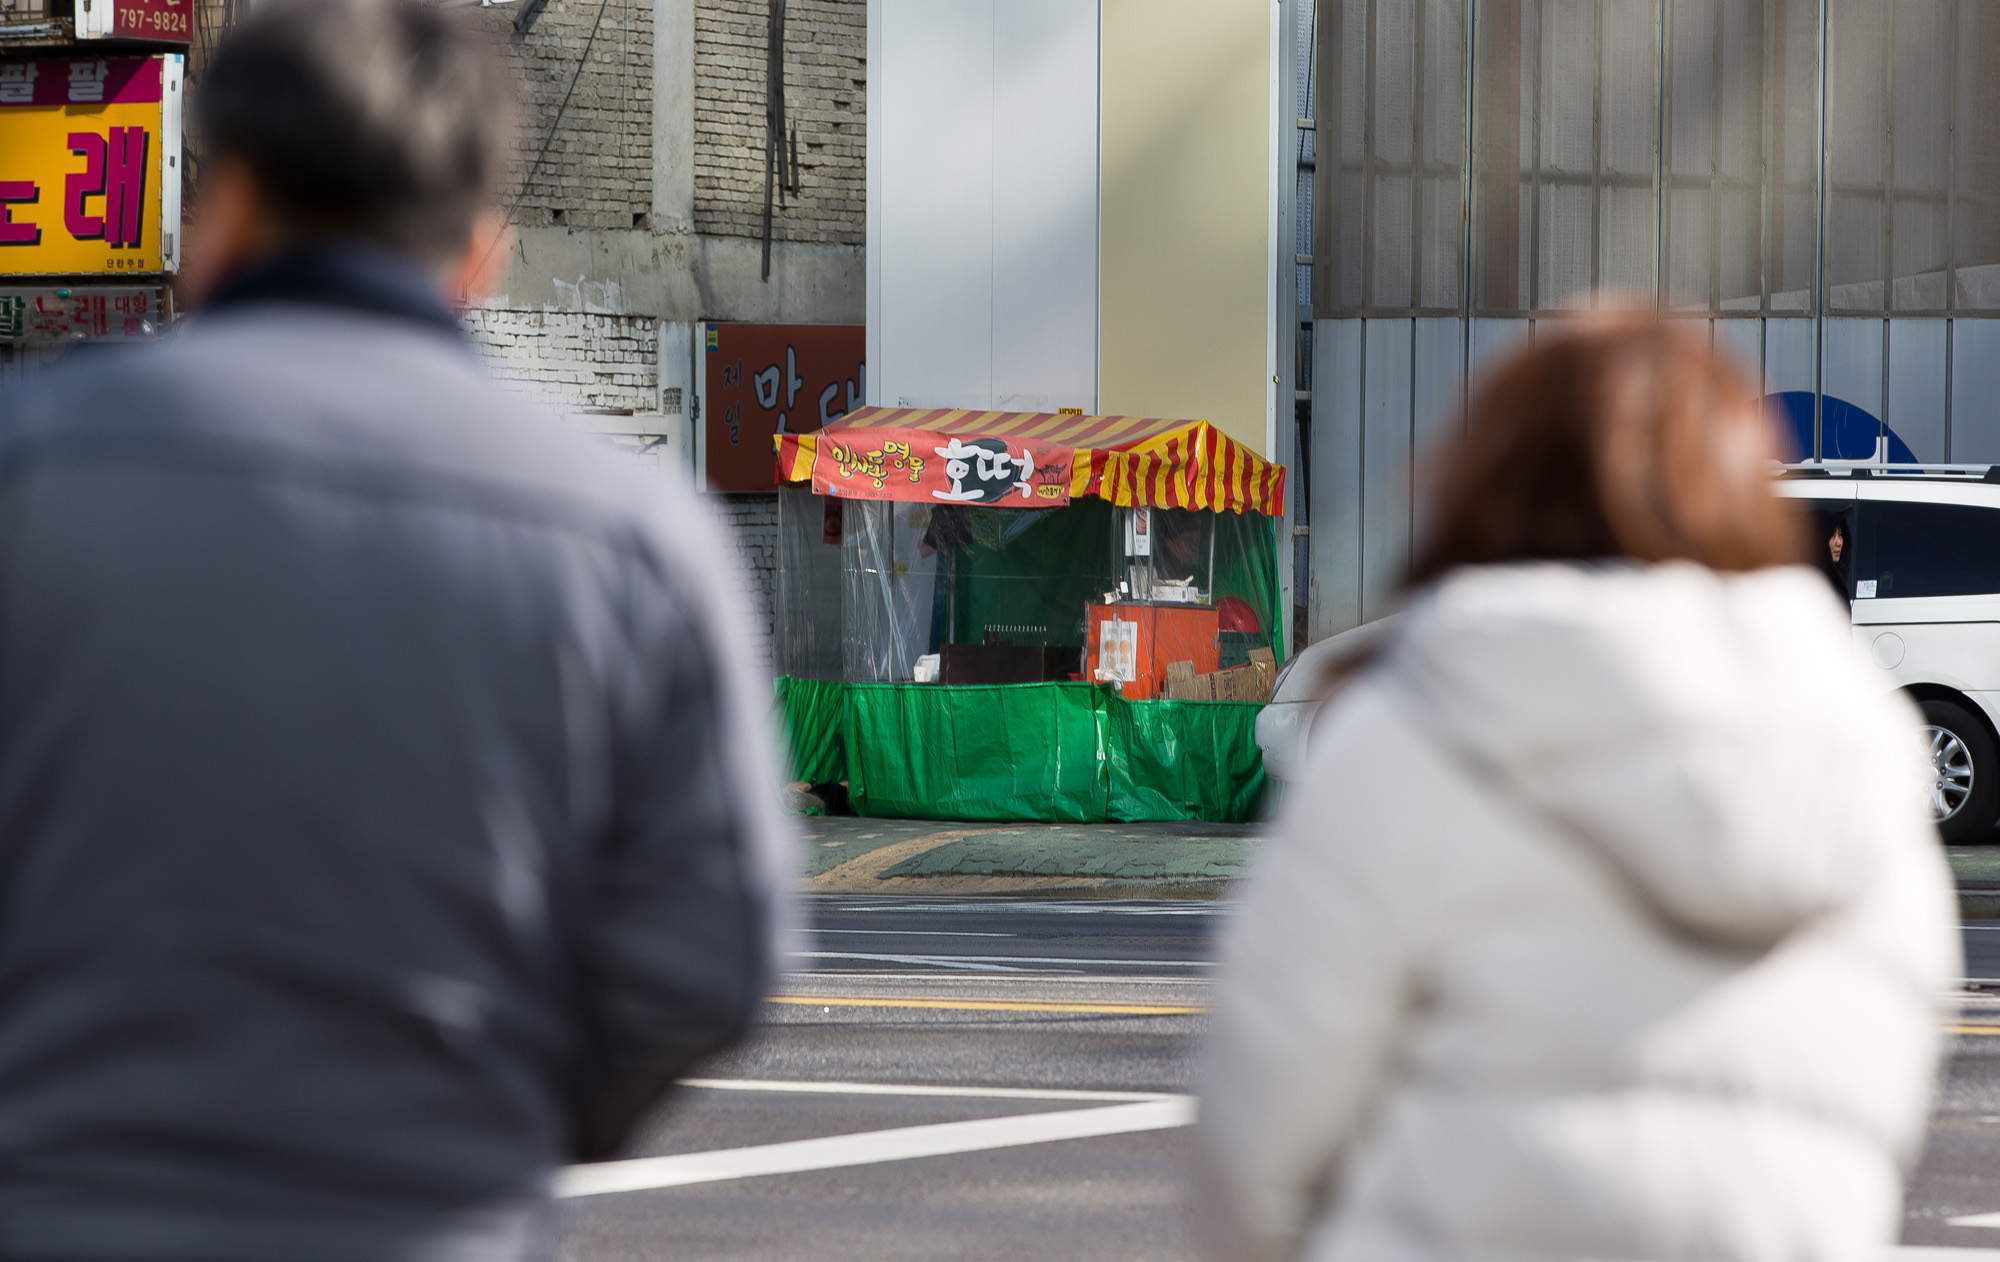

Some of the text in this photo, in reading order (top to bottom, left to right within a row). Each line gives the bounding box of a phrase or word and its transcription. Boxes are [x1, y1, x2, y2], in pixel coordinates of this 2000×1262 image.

[119, 8, 187, 32] 797-9824
[831, 437, 1035, 502] 인사동 명물 호떡
